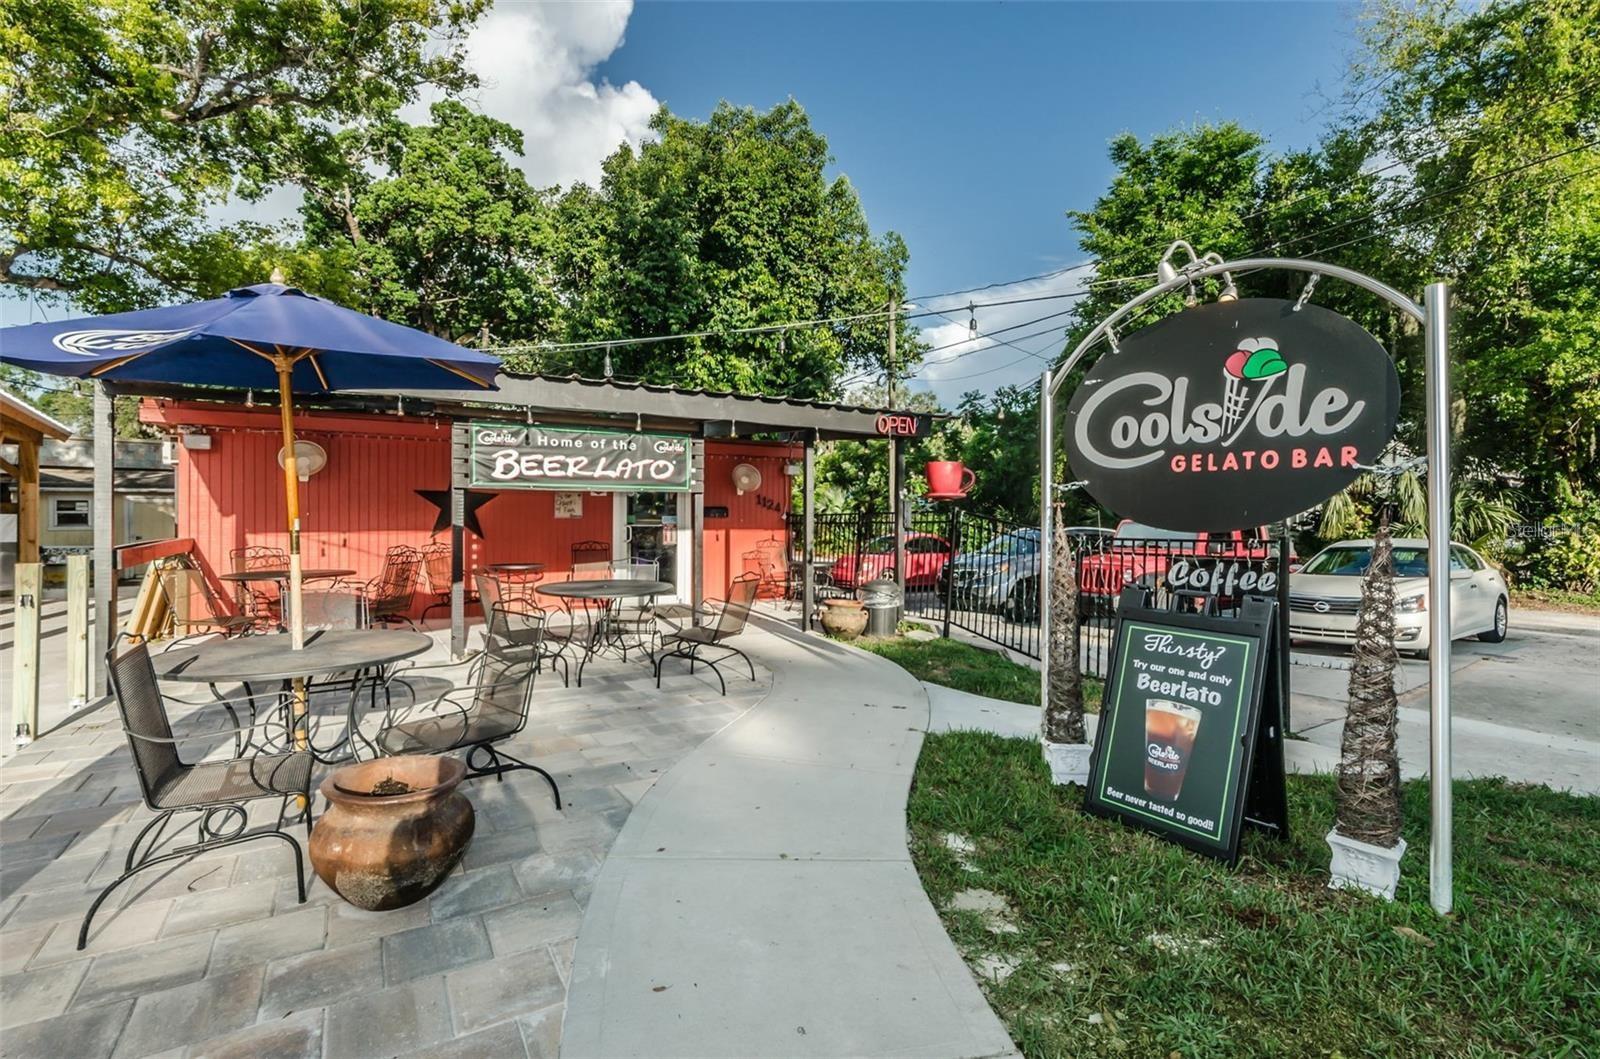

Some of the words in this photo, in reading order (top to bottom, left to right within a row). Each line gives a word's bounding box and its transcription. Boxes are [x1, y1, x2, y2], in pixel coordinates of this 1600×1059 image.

[877, 415, 918, 434] OPEN
[537, 436, 583, 448] Home
[590, 439, 607, 449] of
[613, 439, 637, 451] the
[1170, 449, 1280, 473] GELATO
[1291, 445, 1359, 469] BAR
[491, 449, 675, 480] BEERLATO
[1167, 560, 1277, 596] Coffee
[1144, 634, 1226, 670] Thirsty?
[1133, 659, 1148, 670] Try
[1150, 663, 1166, 672] our
[1168, 667, 1185, 676] one
[1187, 670, 1207, 680] and
[1209, 675, 1233, 686] only
[1136, 672, 1222, 706] Beerlato
[1106, 786, 1124, 799] Beer
[1125, 793, 1147, 807] never
[1148, 801, 1175, 817] tasted
[1176, 811, 1186, 821] so
[1187, 816, 1214, 831] good!!
